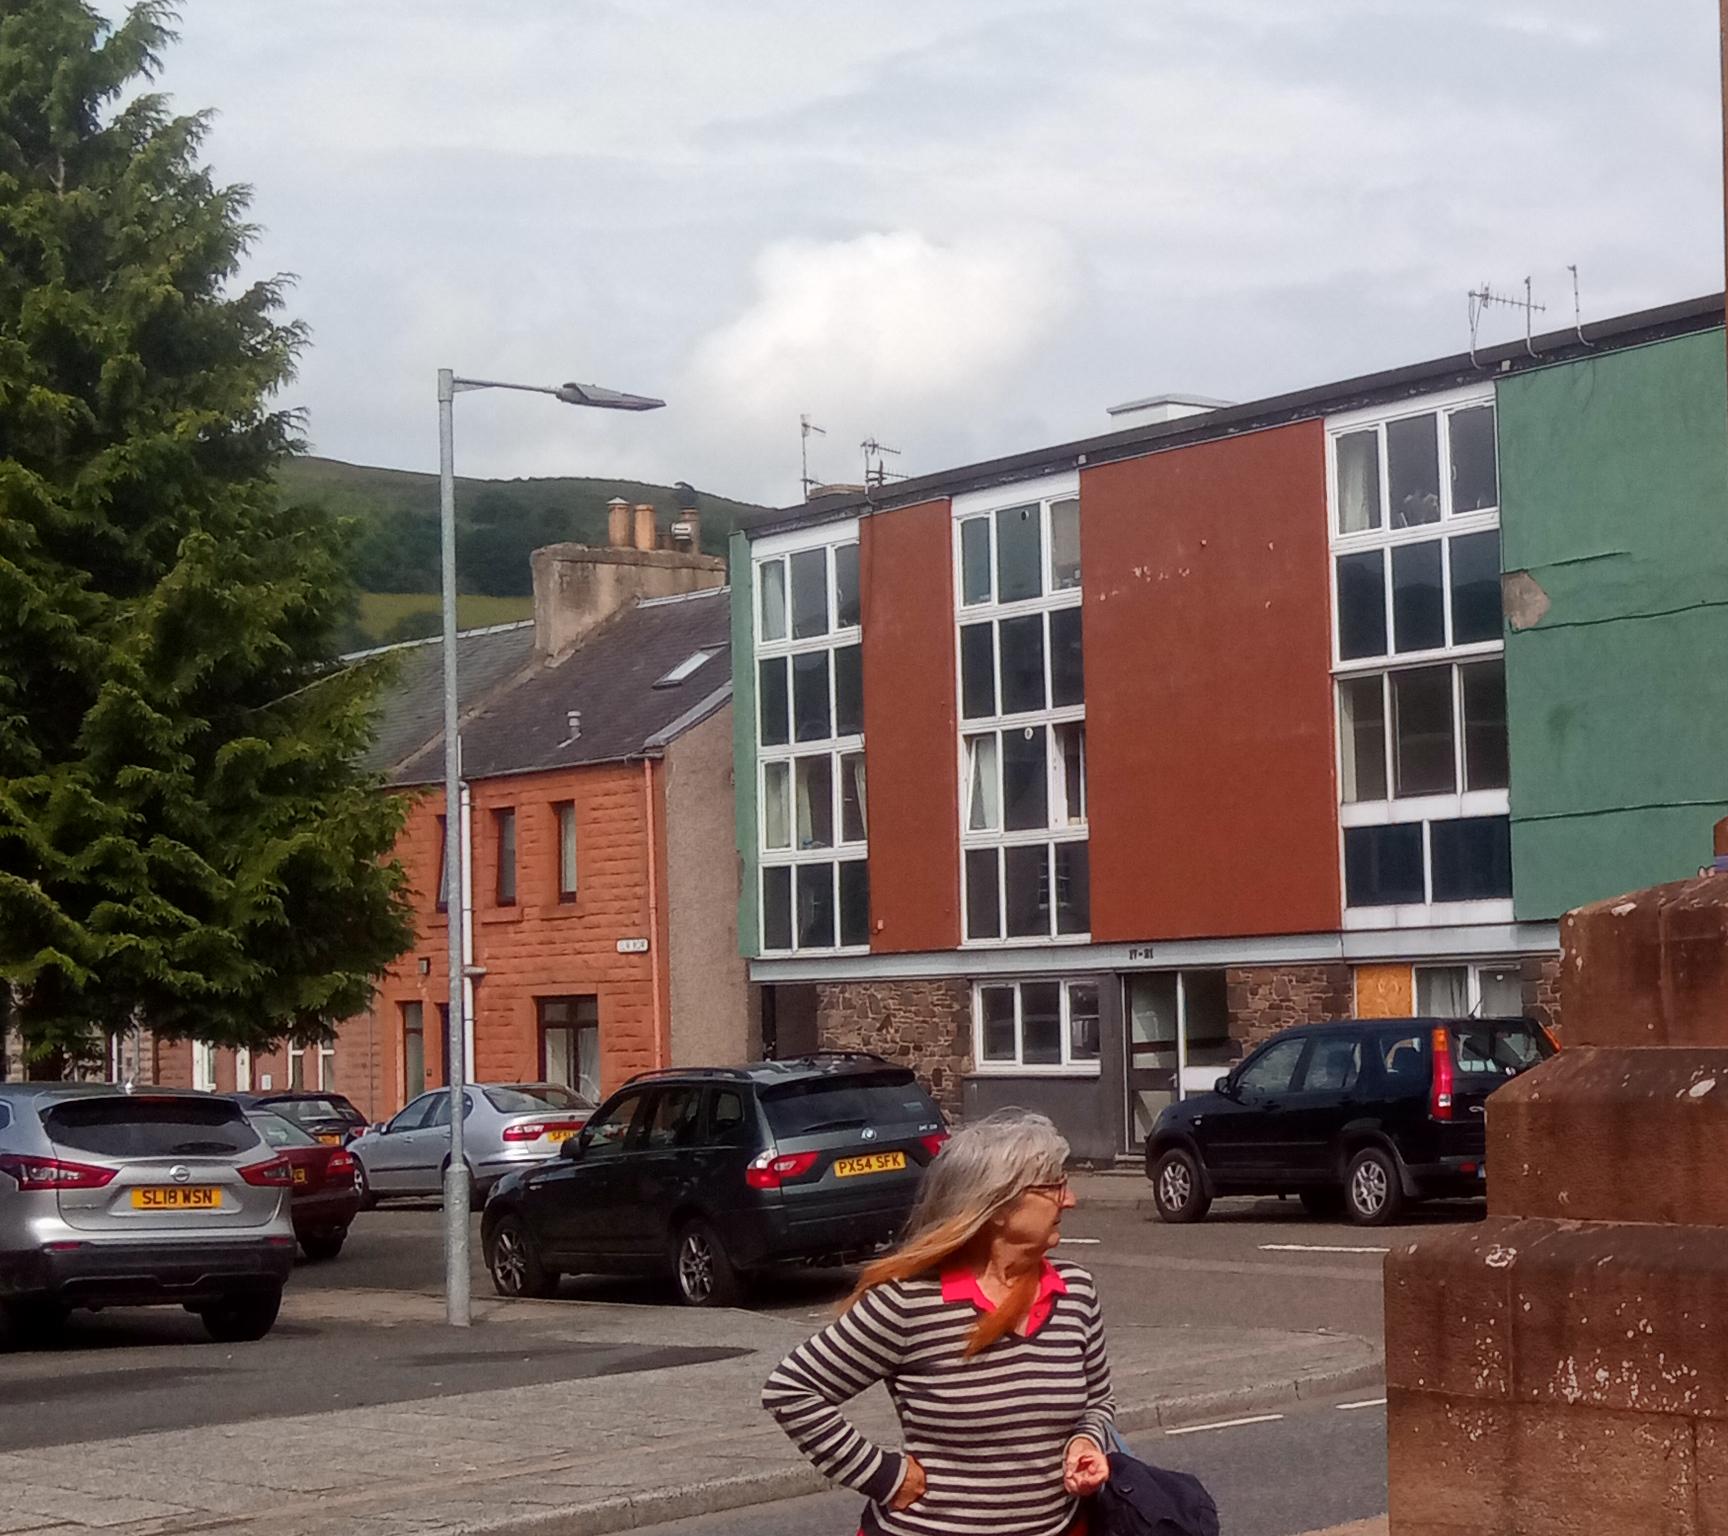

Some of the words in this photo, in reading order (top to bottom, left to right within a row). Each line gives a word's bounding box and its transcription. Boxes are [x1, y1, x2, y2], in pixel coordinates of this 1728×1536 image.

[839, 1158, 872, 1174] PX54
[876, 1154, 902, 1169] SFK
[142, 1189, 178, 1204] SL18
[182, 1189, 213, 1204] WSN
